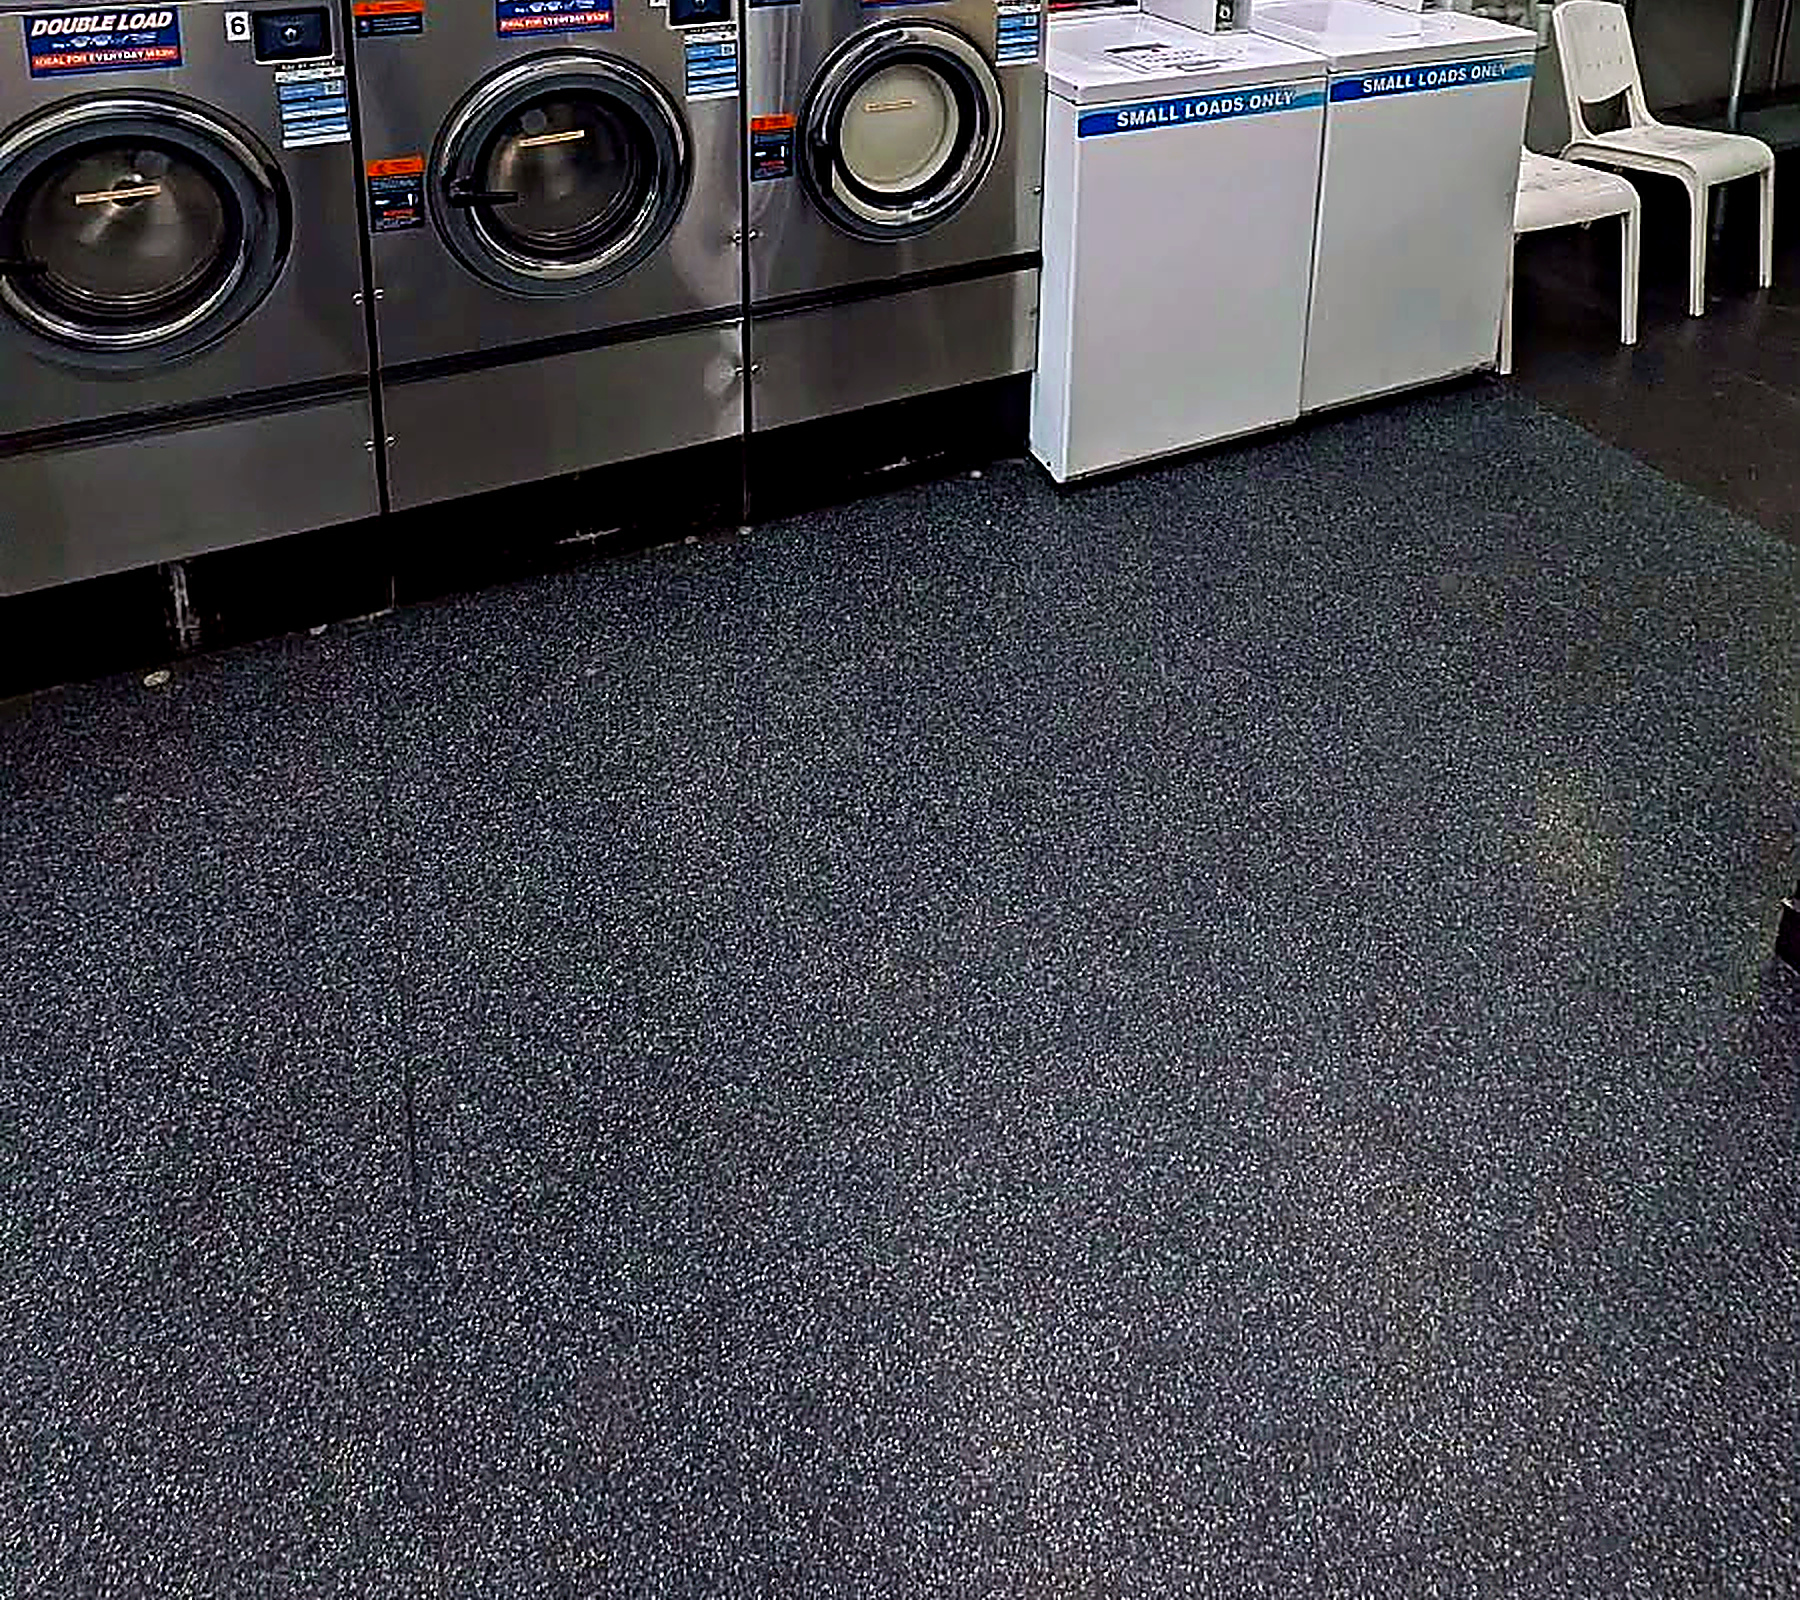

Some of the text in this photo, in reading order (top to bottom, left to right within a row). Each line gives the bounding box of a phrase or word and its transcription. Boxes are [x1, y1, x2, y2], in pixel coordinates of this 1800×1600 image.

[31, 11, 173, 37] DOUBLE LOAD
[231, 16, 246, 35] 6
[1363, 62, 1508, 94] SMALL LOADS ONLY
[1116, 90, 1295, 128] SMALL LOADS ONLY
